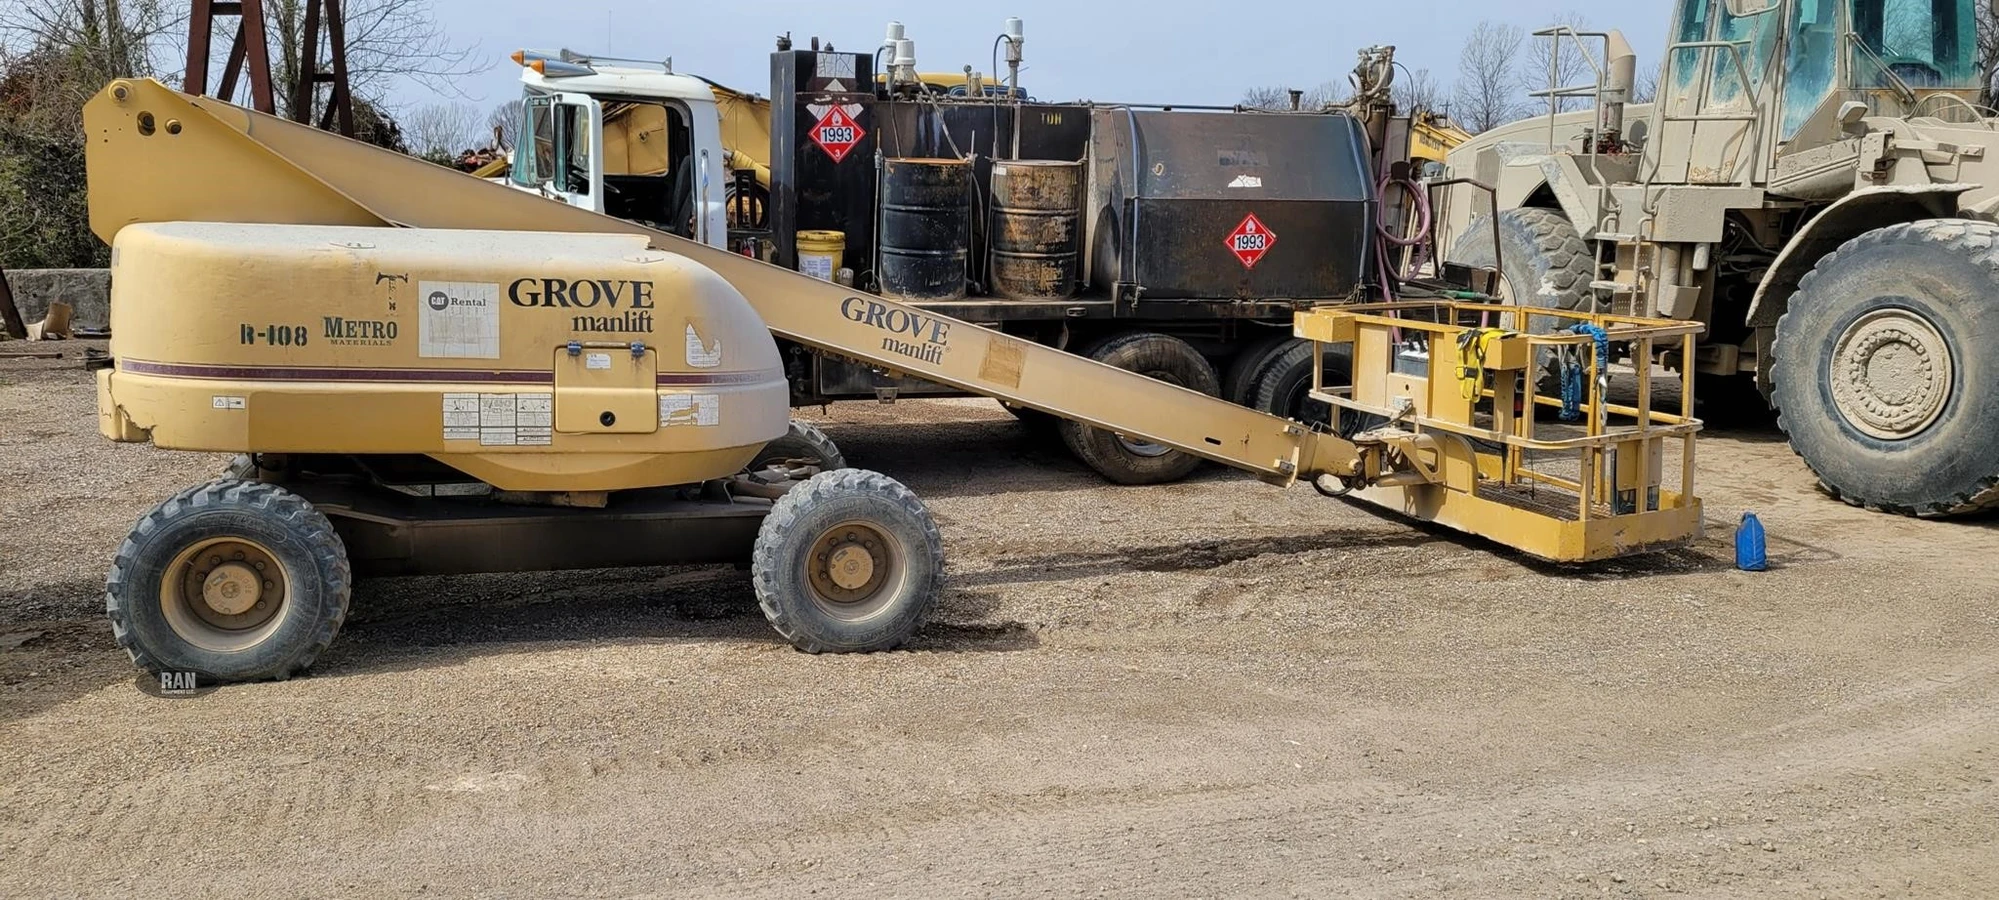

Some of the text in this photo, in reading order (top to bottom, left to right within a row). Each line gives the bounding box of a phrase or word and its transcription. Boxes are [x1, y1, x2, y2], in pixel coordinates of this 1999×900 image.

[822, 127, 852, 142] 1993
[834, 149, 840, 158] 3
[1236, 234, 1264, 250] 1993
[1246, 255, 1252, 264] 3
[431, 296, 487, 307] CAT Rental
[508, 278, 654, 309] GROVE
[572, 310, 654, 333] manlift
[841, 297, 951, 346] GROVE
[240, 323, 308, 347] R-108
[882, 337, 943, 365] manlift
